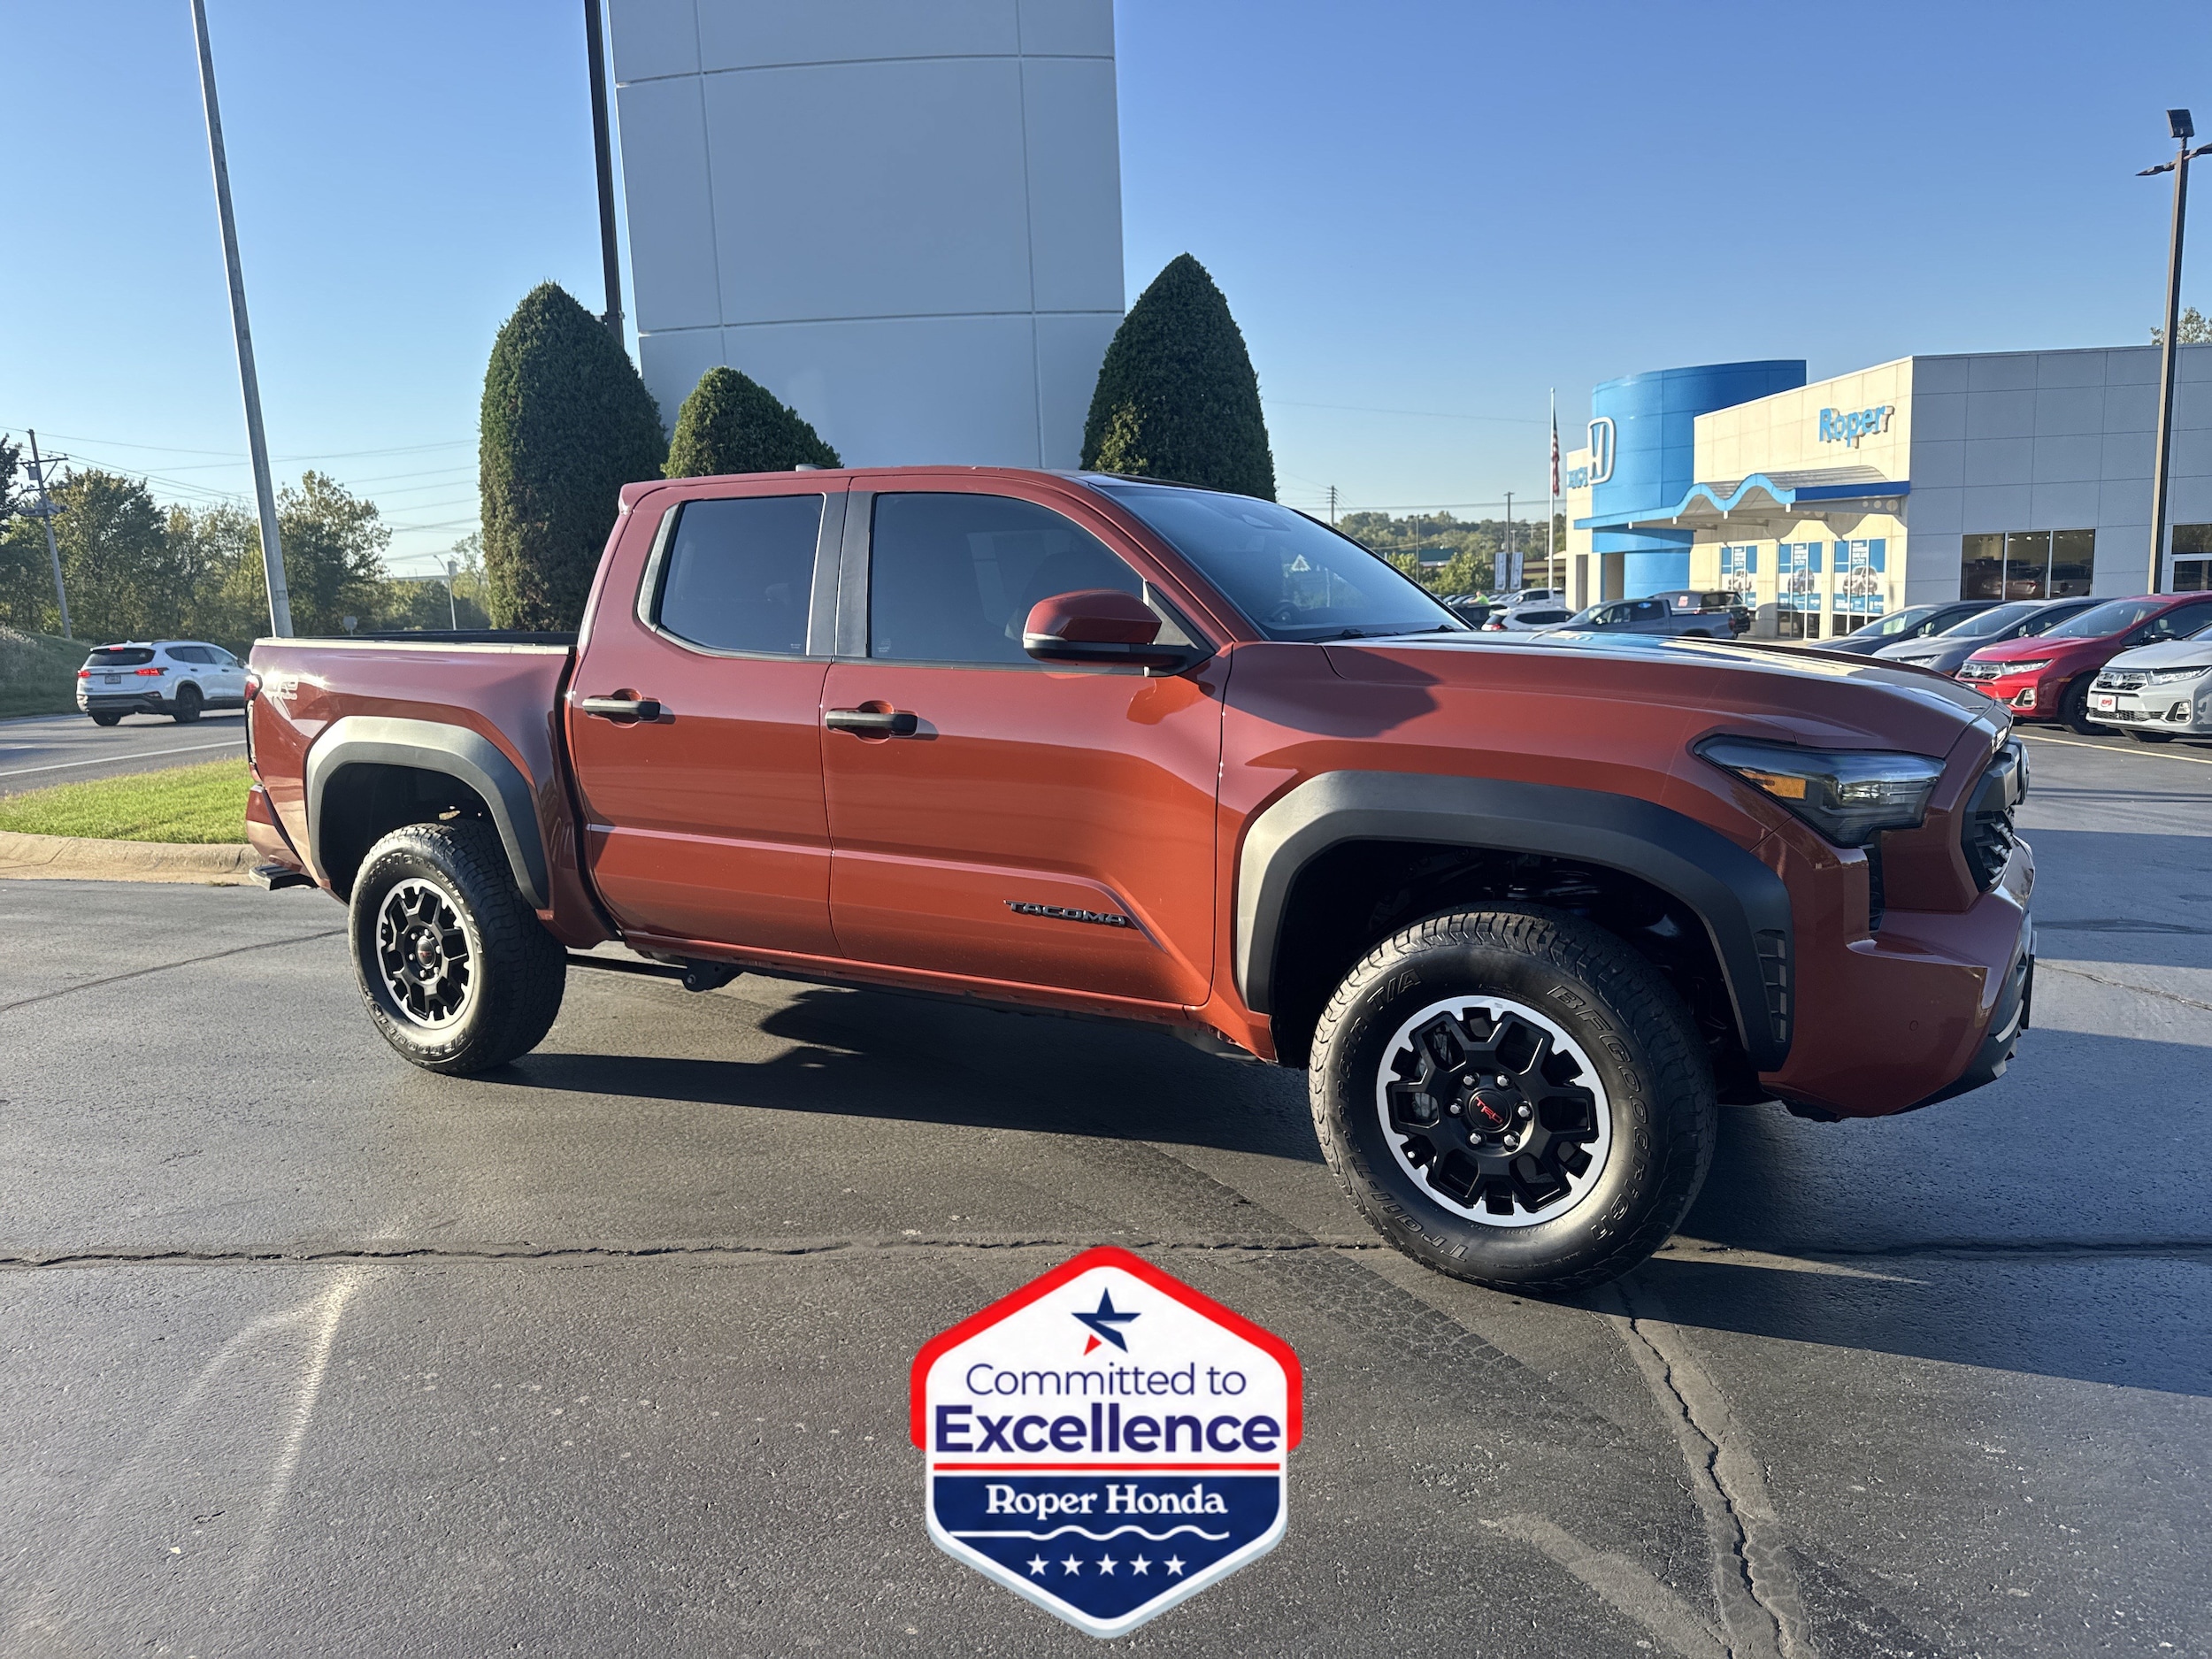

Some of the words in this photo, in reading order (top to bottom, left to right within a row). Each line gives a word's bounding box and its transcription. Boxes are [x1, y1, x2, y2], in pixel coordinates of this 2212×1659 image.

[1819, 405, 1893, 448] Roper
[1003, 899, 1126, 927] TACOMA
[1476, 1096, 1503, 1125] TRD
